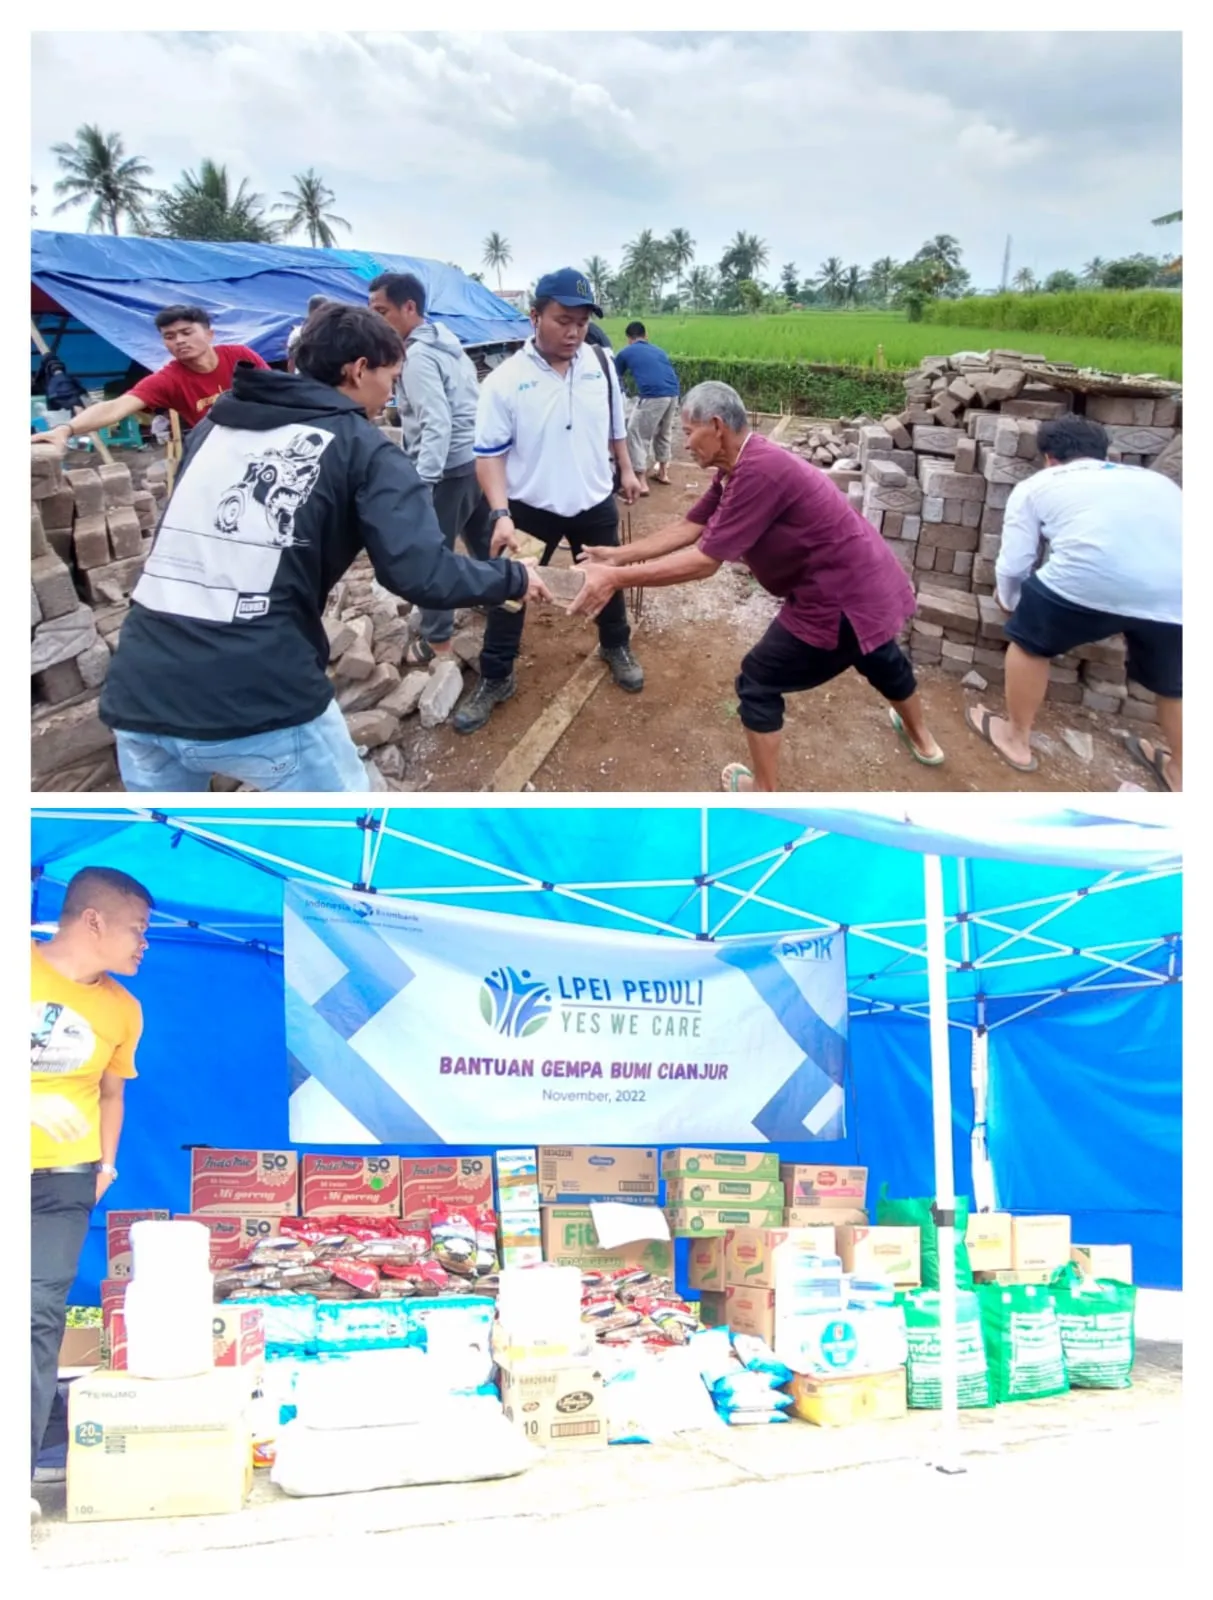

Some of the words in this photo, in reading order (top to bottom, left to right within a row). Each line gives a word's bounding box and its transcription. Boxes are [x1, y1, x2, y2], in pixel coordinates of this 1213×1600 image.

[782, 936, 833, 960] APIK
[558, 975, 611, 1001] LPEI
[622, 979, 703, 1006] PEDULI
[561, 1010, 601, 1034] YES
[611, 1013, 639, 1035] WE
[652, 1015, 702, 1038] CARE
[439, 1056, 534, 1078] BANTUAN
[541, 1060, 603, 1079] GEMPA
[610, 1062, 652, 1080] BUMI
[657, 1063, 729, 1081] CIANJUR
[542, 1089, 612, 1104] November,
[615, 1090, 647, 1103] 2022
[262, 1153, 288, 1171] 50
[367, 1157, 390, 1173] 50
[461, 1159, 483, 1176] 50
[234, 1191, 276, 1201] goreng
[342, 1194, 380, 1203] goreng
[246, 1219, 271, 1237] 50
[80, 1424, 96, 1438] 20
[523, 1419, 539, 1436] 10
